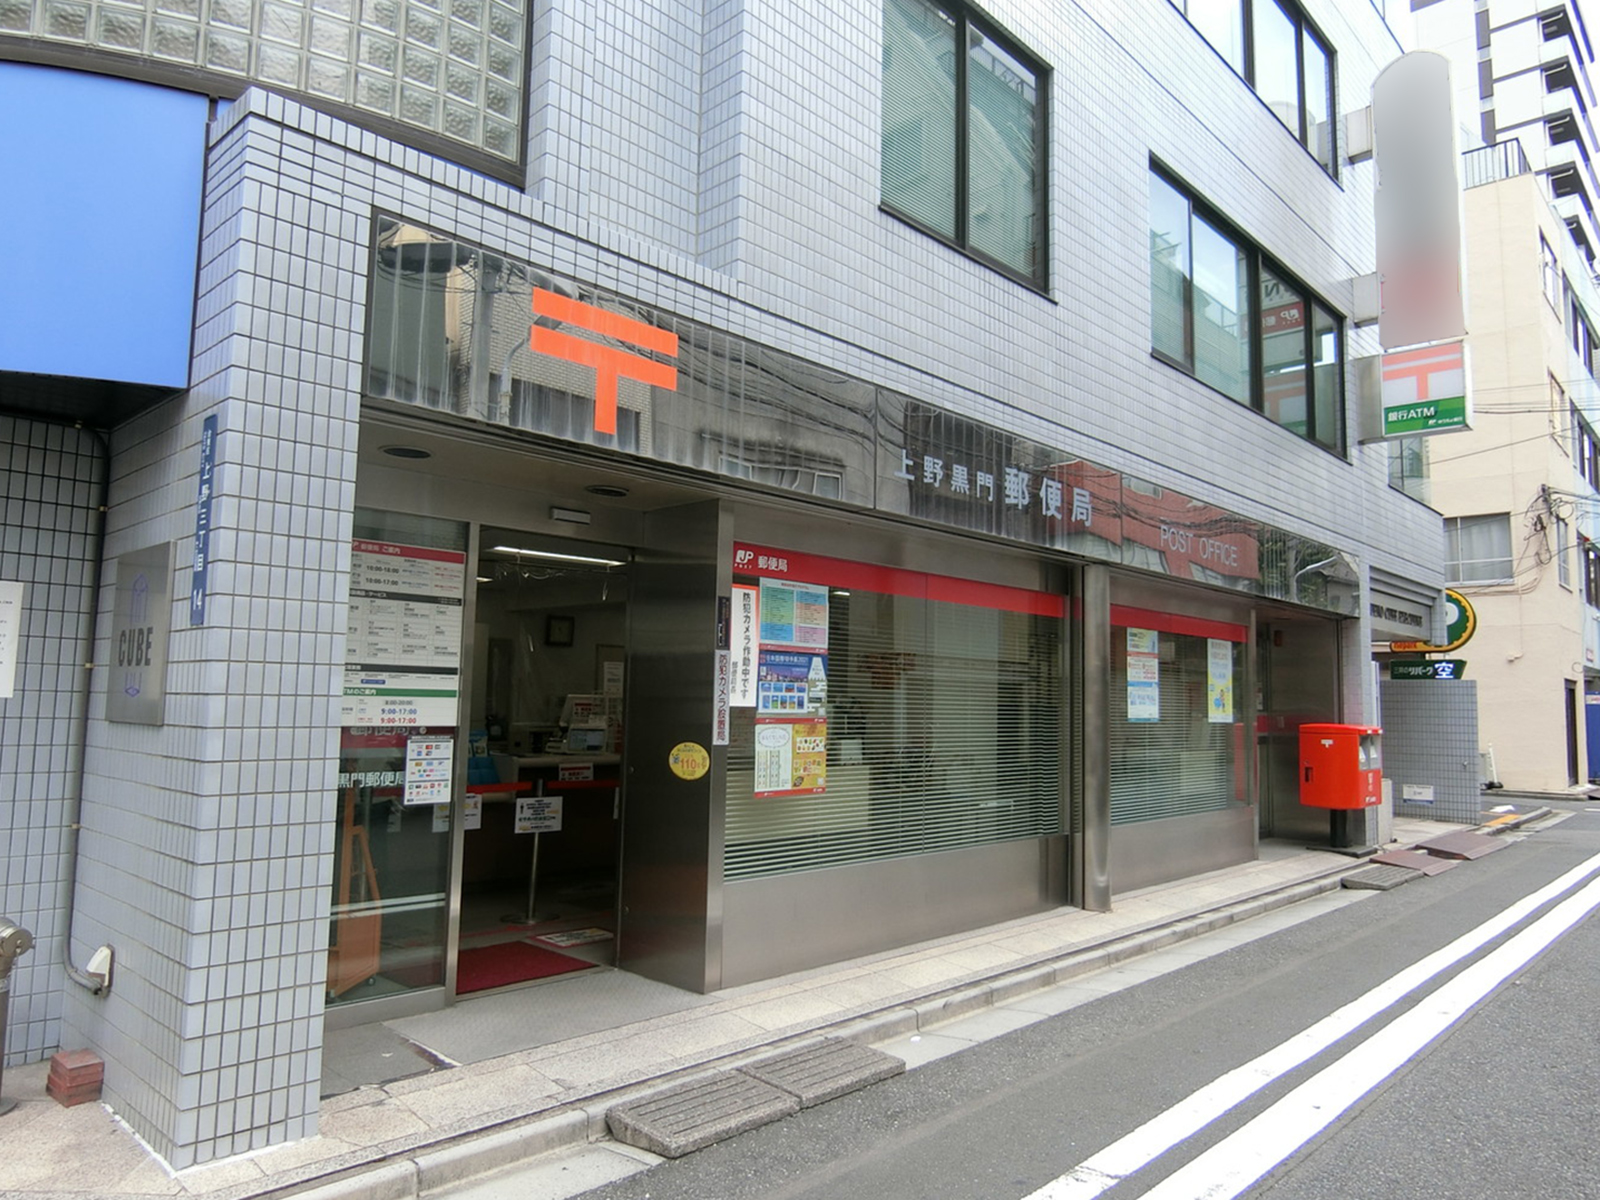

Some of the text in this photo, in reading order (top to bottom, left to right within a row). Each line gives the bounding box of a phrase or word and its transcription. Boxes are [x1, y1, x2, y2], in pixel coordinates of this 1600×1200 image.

[1387, 406, 1435, 422] 銀行ATM
[894, 449, 1093, 527] 上野黒門郵便局
[758, 555, 788, 572] 郵便局
[1160, 525, 1238, 567] POST OFFICE
[118, 626, 153, 667] CUBE
[740, 592, 751, 699] 防犯カメラ作動中です
[1434, 661, 1455, 679] 空
